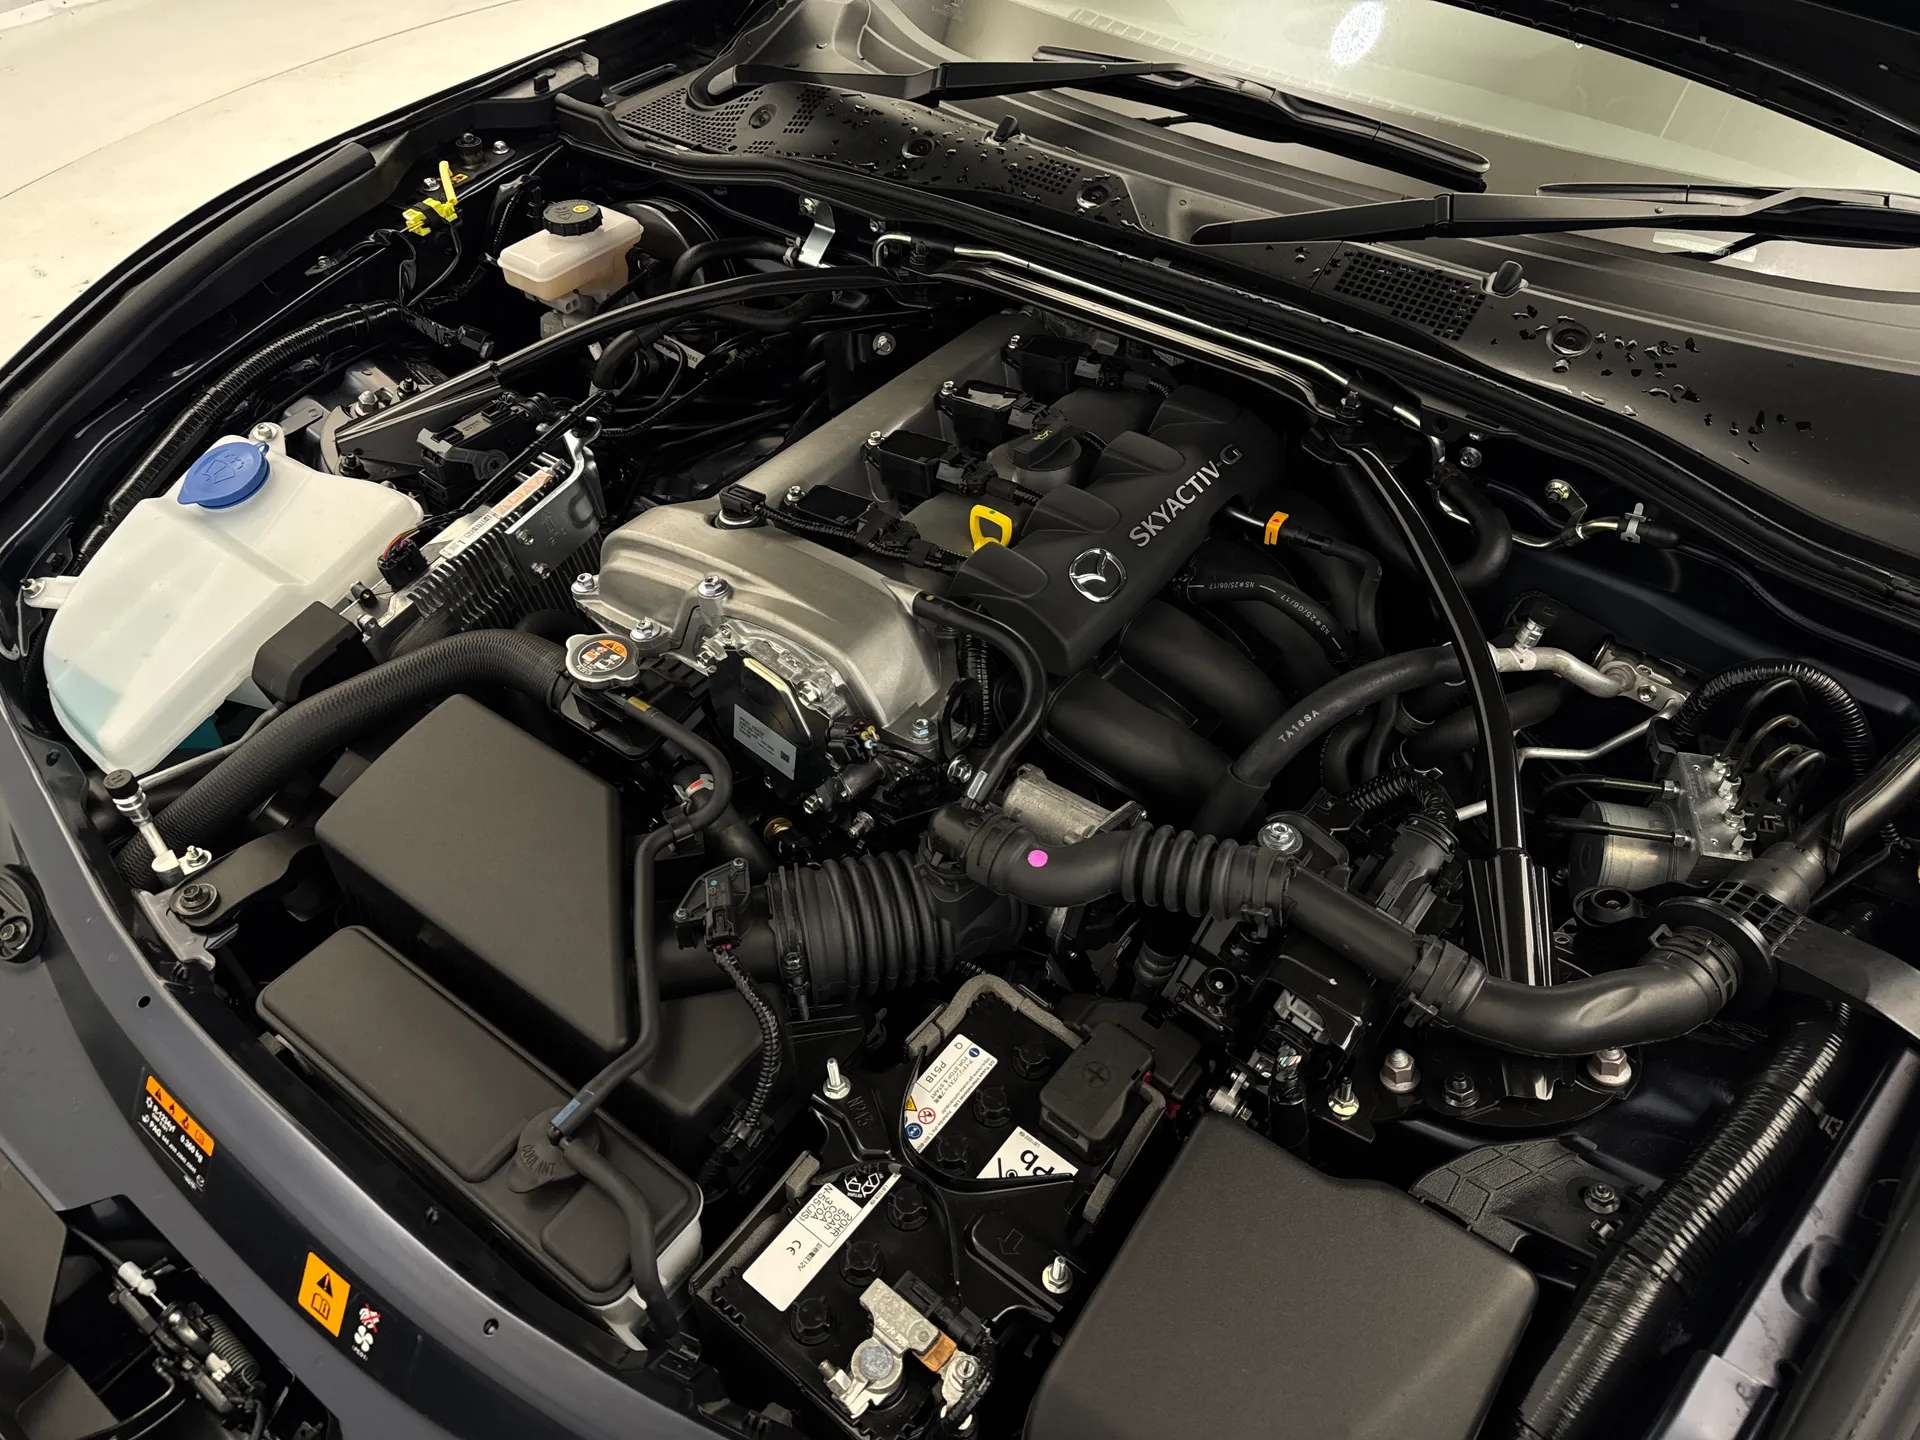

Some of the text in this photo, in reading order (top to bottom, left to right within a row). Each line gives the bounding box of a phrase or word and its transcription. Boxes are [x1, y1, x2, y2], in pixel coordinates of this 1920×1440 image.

[1129, 443, 1242, 547] SKYACTIV-G
[925, 1061, 947, 1084] P51B
[799, 1184, 834, 1222] N-55(JIS)
[810, 1197, 834, 1221] 370A
[819, 1205, 838, 1223] CCA
[824, 1209, 847, 1231] 50Ah
[830, 1215, 853, 1238] 20HR
